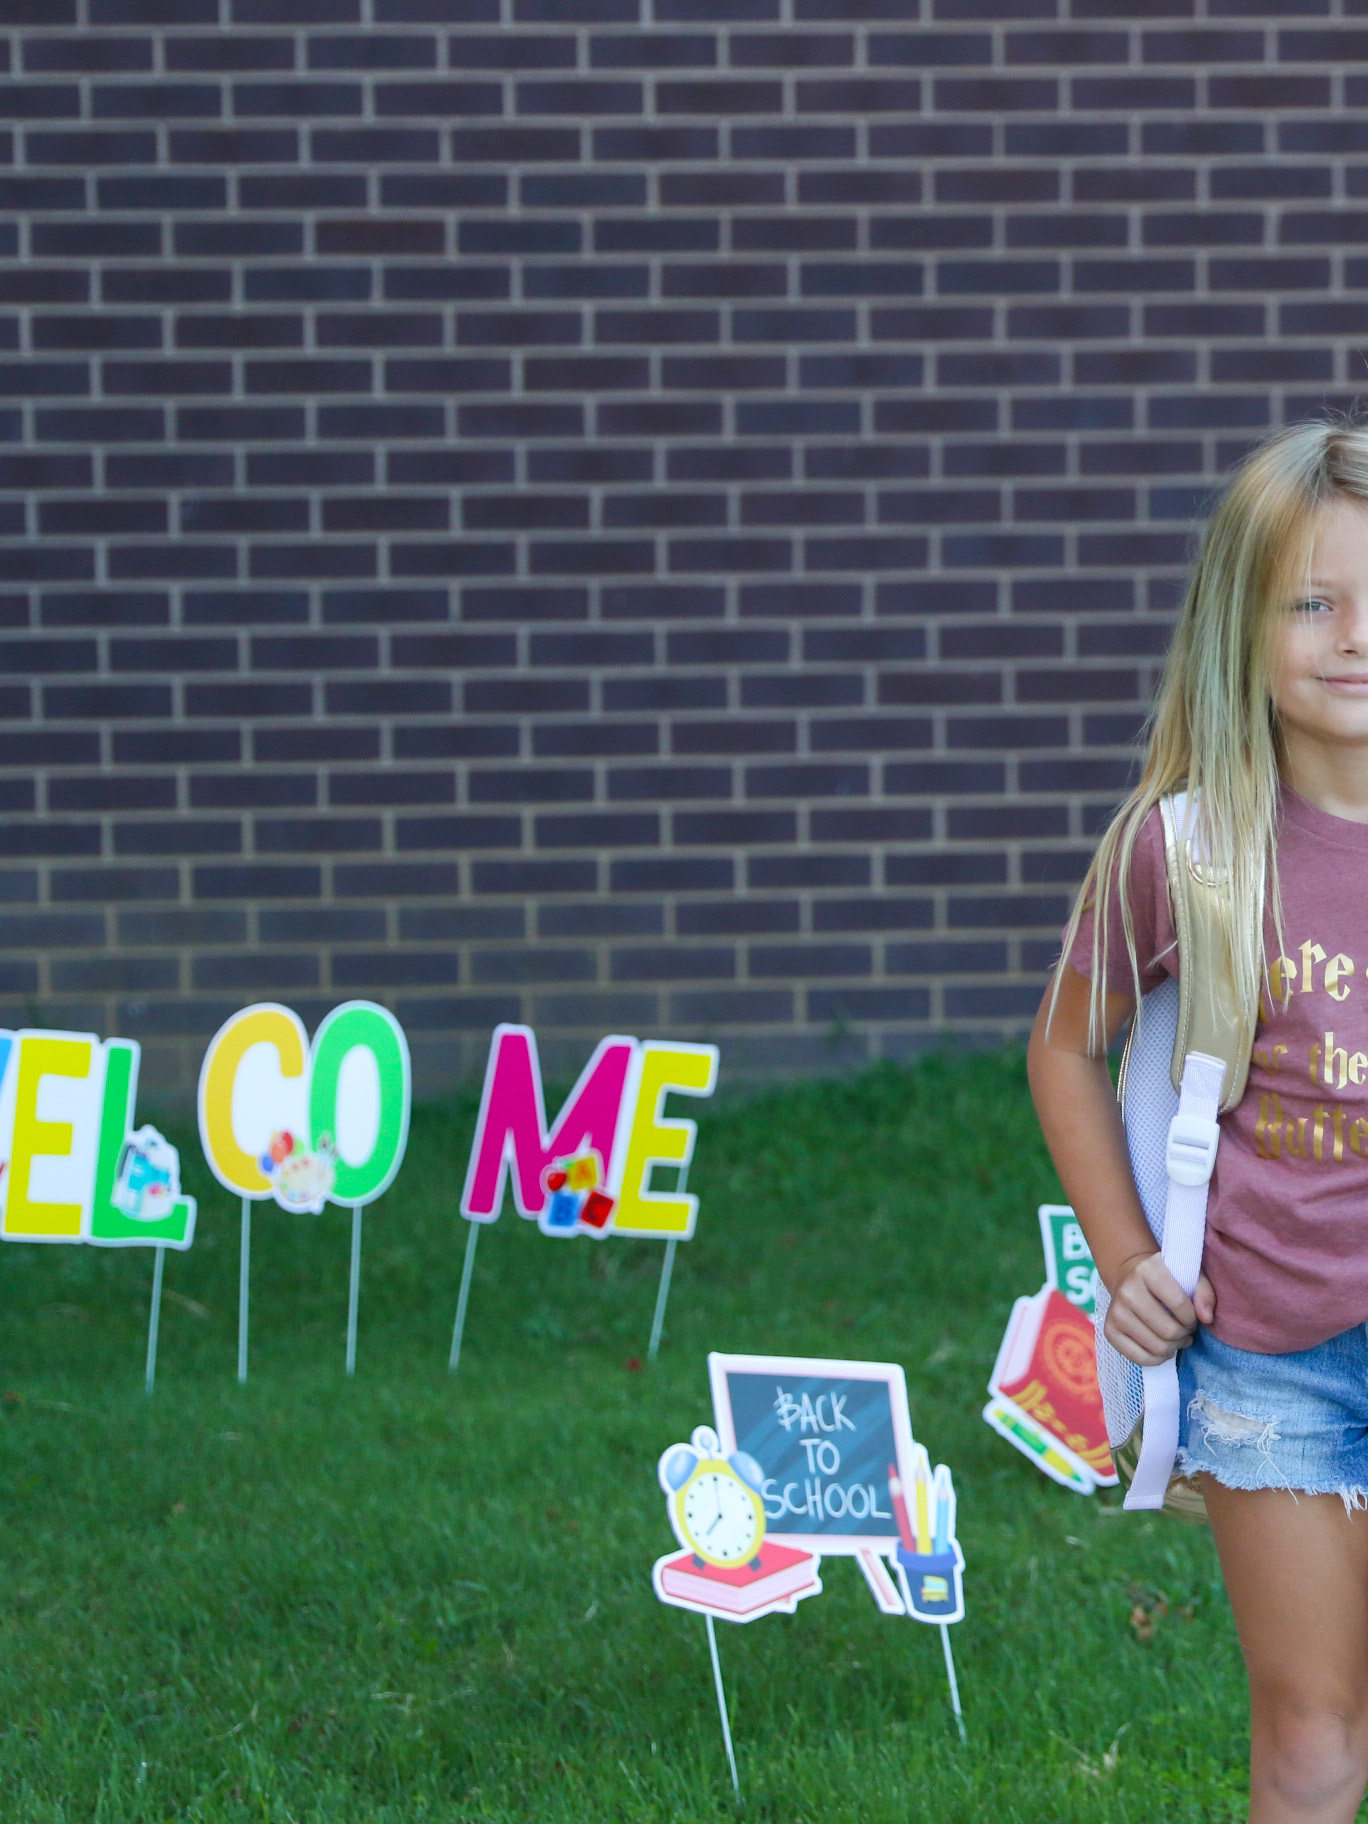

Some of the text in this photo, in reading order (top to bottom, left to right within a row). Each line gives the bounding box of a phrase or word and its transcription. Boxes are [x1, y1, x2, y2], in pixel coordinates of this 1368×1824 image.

[1259, 938, 1355, 1012] ere
[1252, 1031, 1368, 1090] or the
[0, 1004, 717, 1243] ELCOME
[773, 1385, 857, 1433] BACK
[799, 1438, 841, 1475] TO
[760, 1477, 893, 1521] SCHOOL
